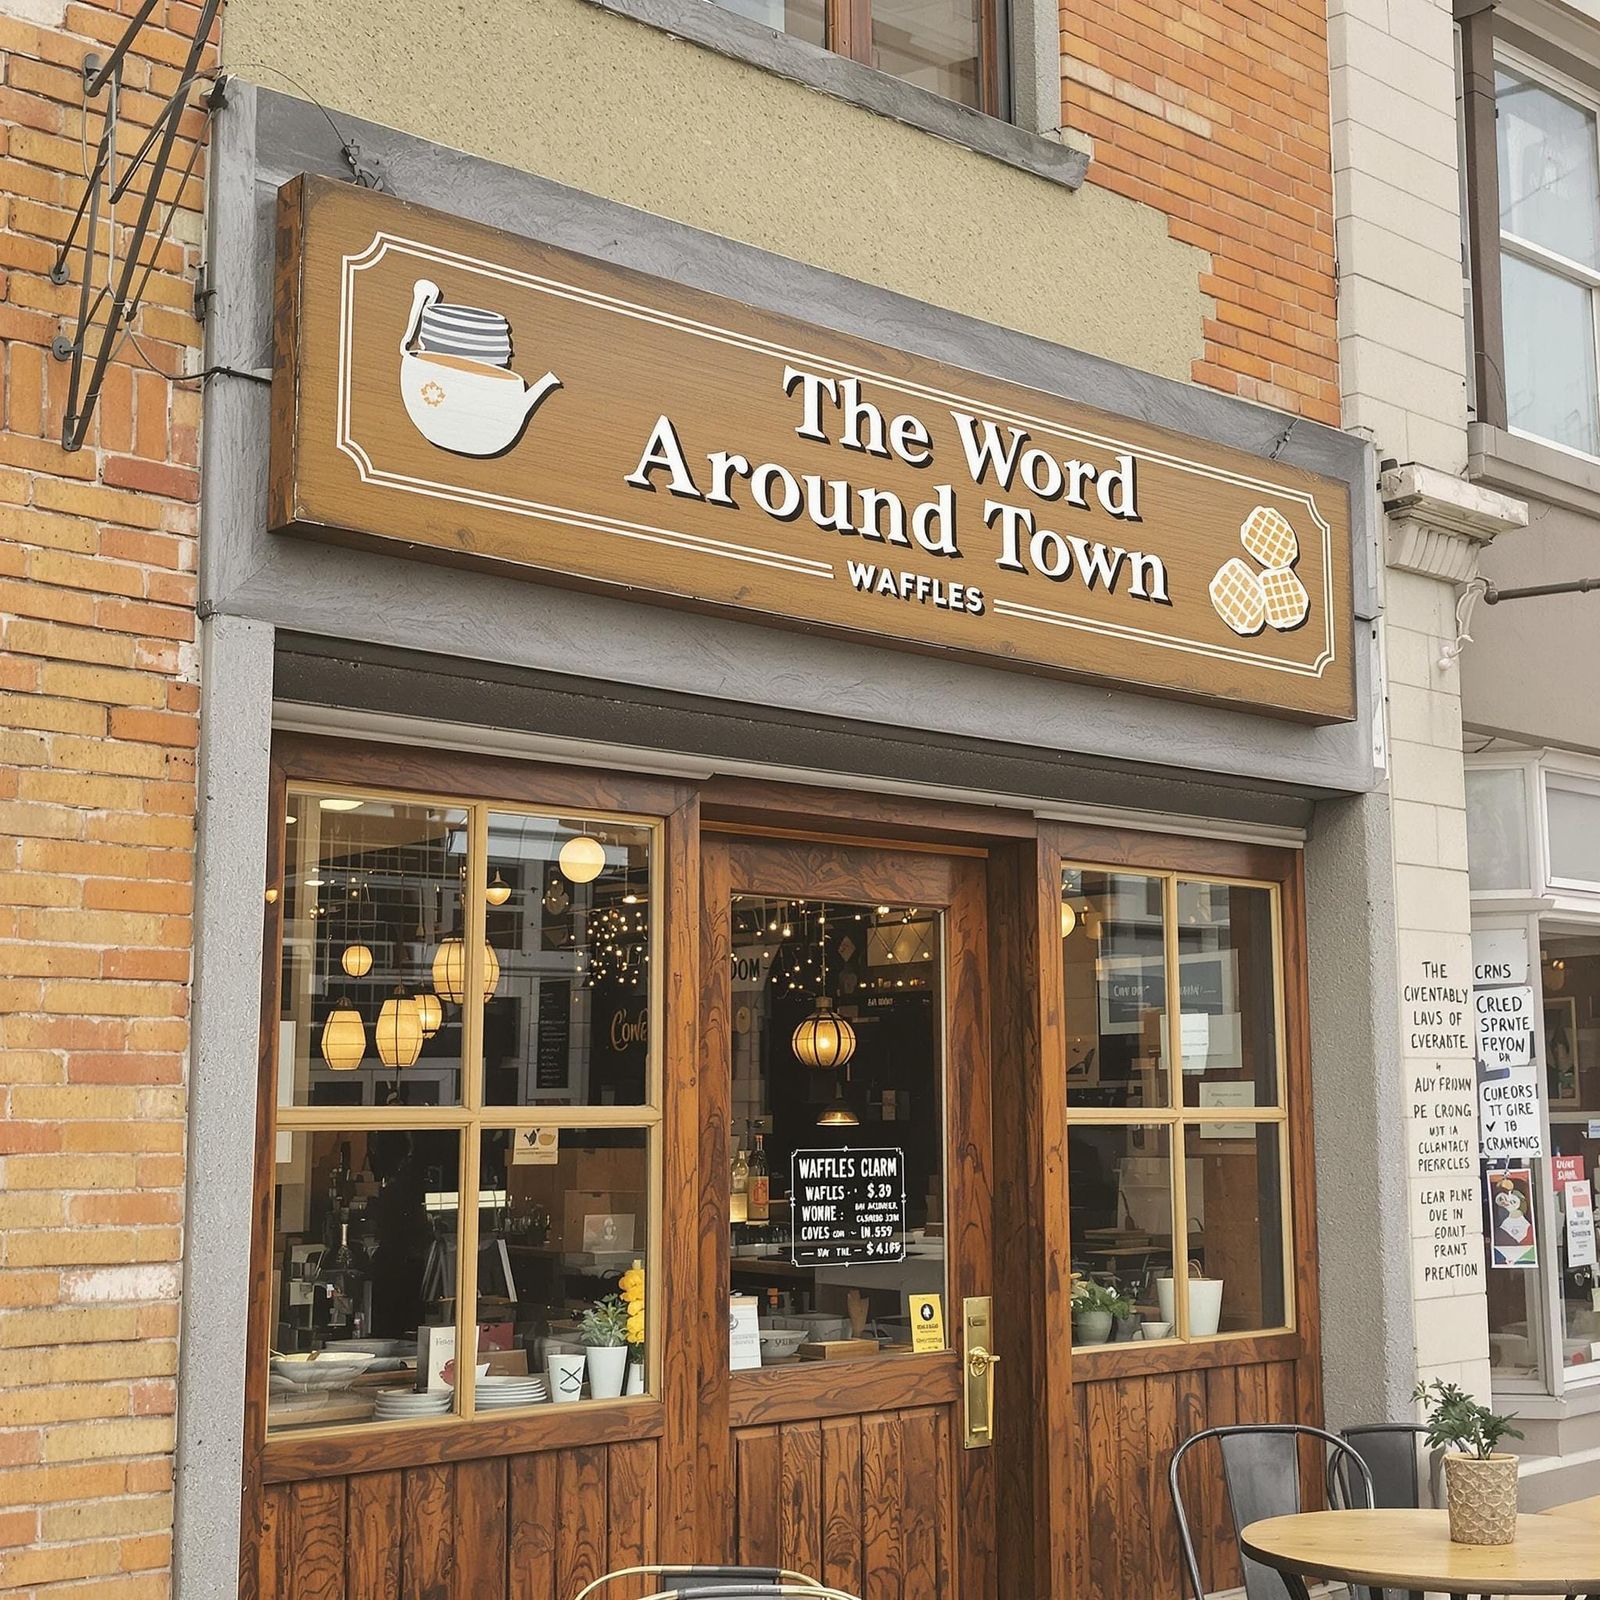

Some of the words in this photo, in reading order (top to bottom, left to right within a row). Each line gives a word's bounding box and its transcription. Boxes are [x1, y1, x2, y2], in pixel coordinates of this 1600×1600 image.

[782, 365, 933, 467] The
[950, 410, 1143, 522] Word
[623, 414, 963, 558] Around
[983, 499, 1173, 606] Town
[846, 559, 986, 615] WAFFLES
[1422, 961, 1448, 979] THE
[1449, 1011, 1462, 1026] OF
[1413, 1103, 1428, 1119] PE
[799, 1158, 855, 1179] WAFFLES
[1429, 1208, 1448, 1222] OVE
[1453, 1208, 1463, 1220] IN
